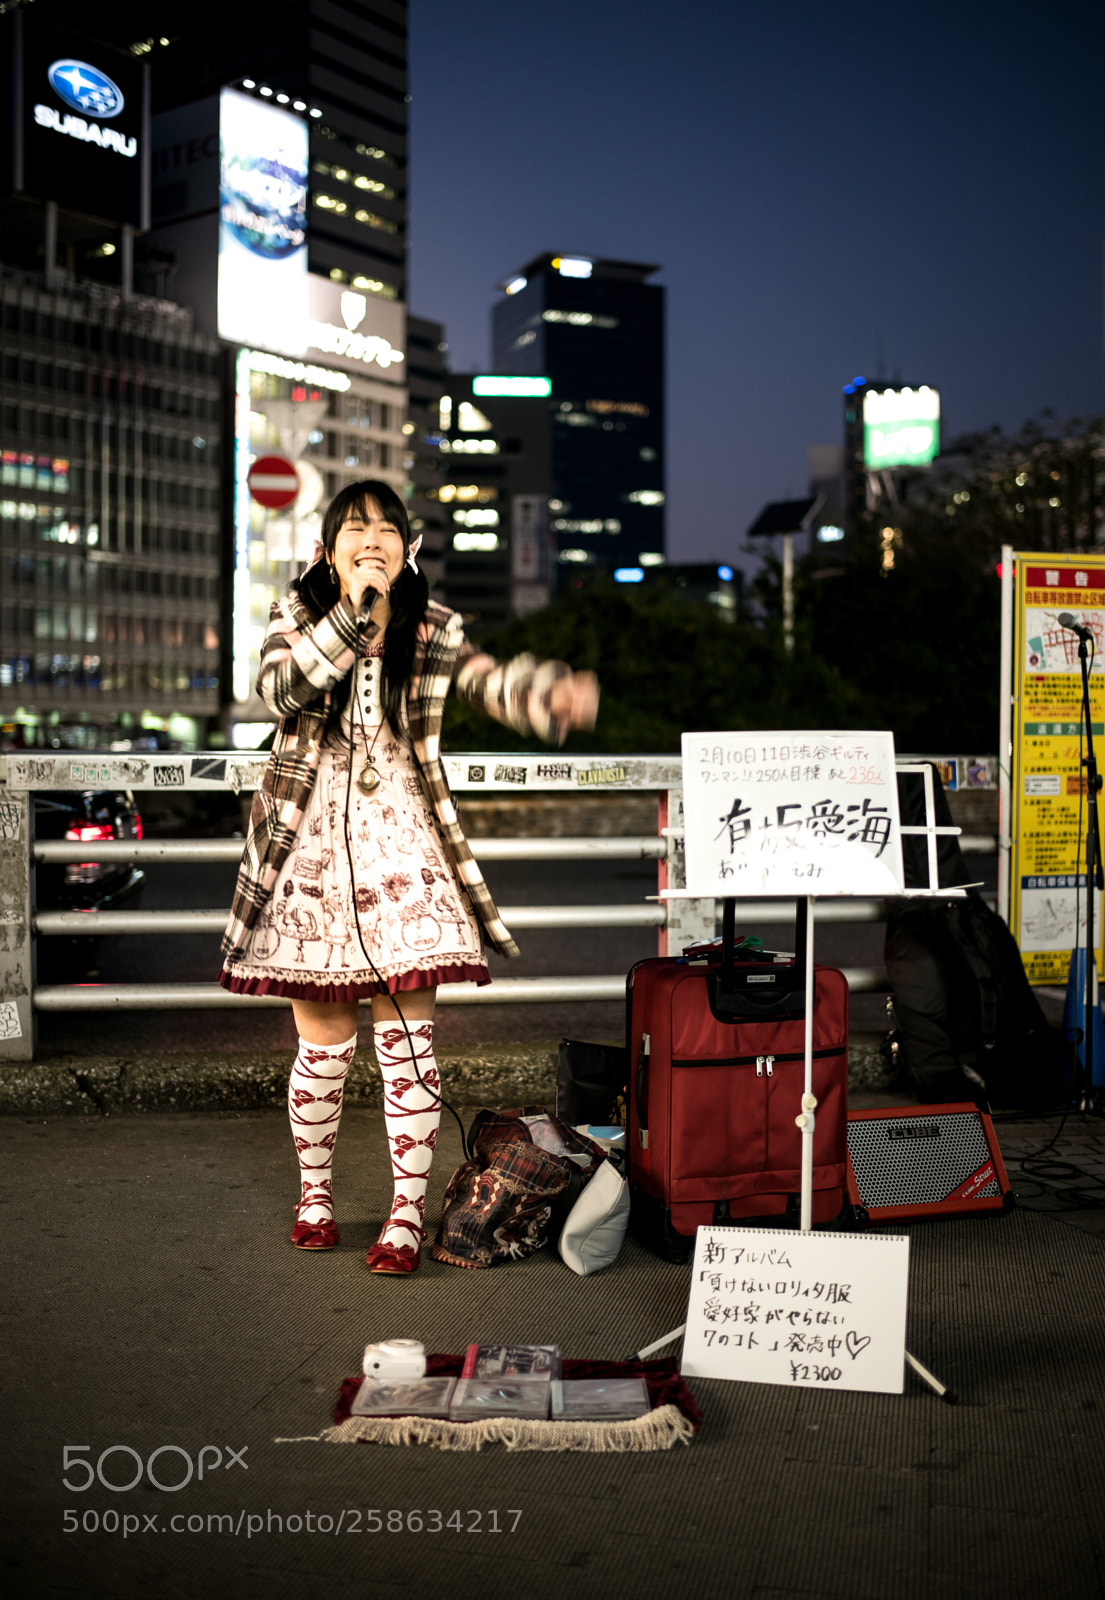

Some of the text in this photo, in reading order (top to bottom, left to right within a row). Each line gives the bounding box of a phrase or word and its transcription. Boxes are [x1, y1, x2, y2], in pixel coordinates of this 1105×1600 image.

[34, 103, 137, 157] SUBARU
[703, 1236, 792, 1268] 新アルバム
[790, 1360, 843, 1381] ¥2300
